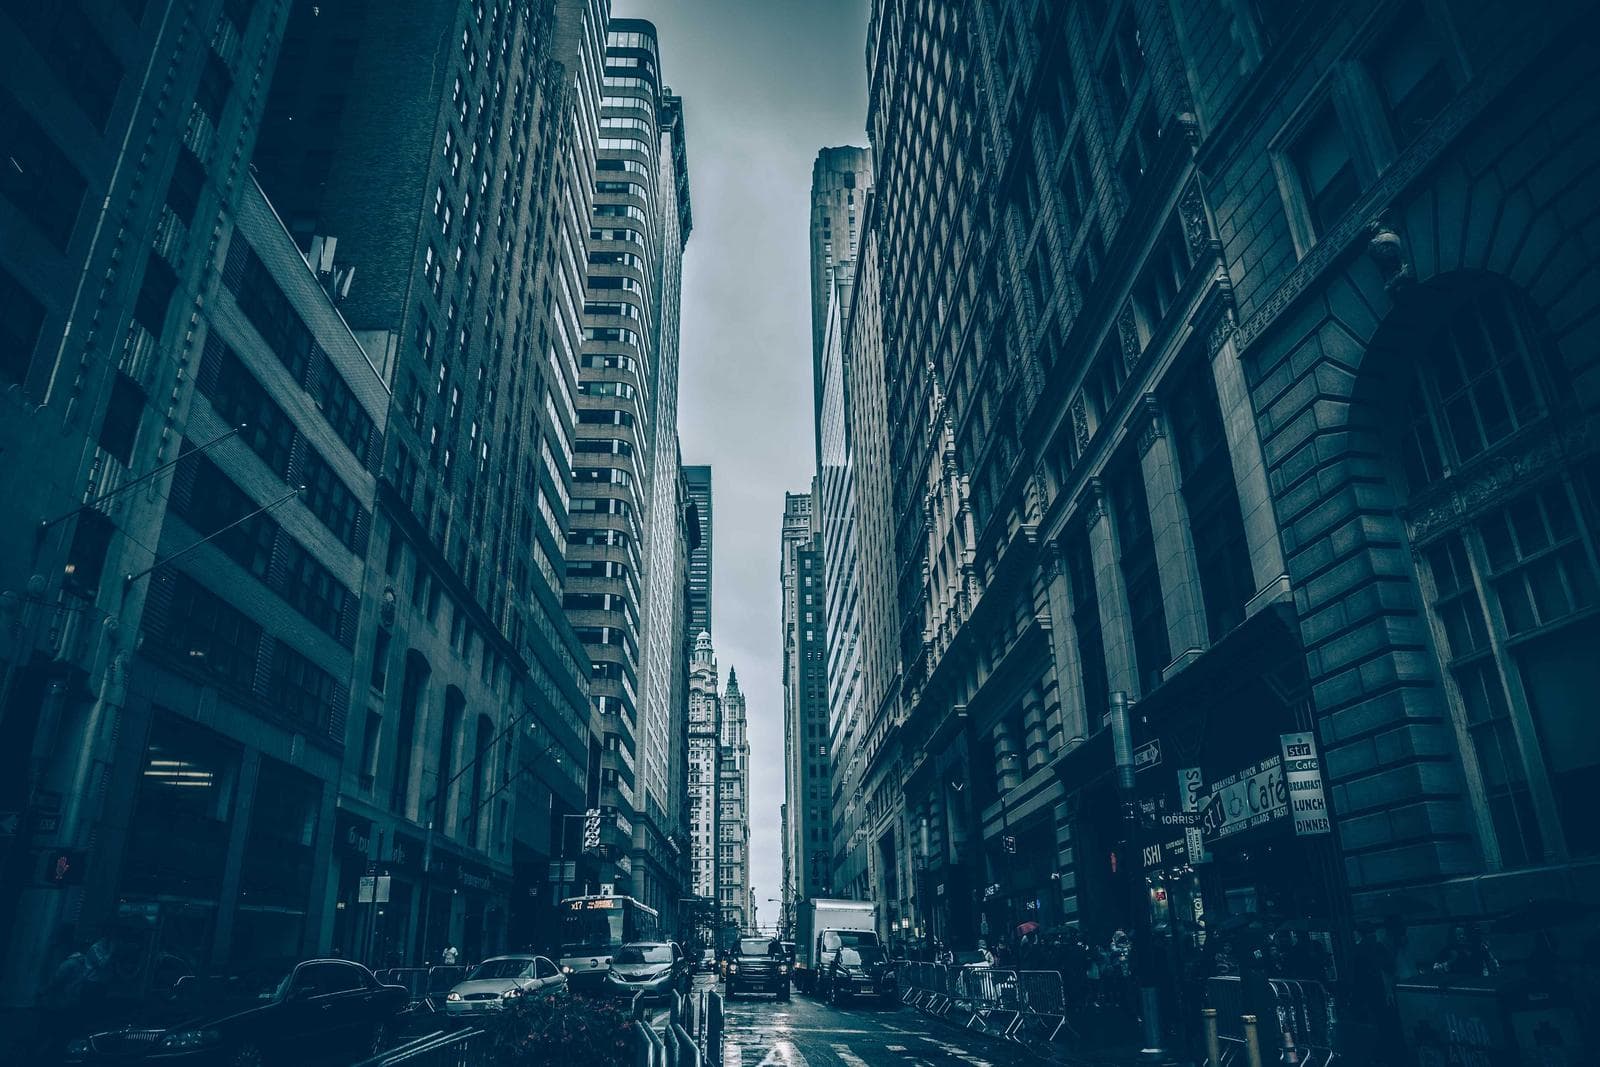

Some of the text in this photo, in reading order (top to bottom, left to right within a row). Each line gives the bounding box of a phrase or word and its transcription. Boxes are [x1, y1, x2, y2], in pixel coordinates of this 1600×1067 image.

[1288, 780, 1321, 791] BREAKFAST
[1248, 773, 1286, 813] Café
[1294, 799, 1324, 811] LUNCH
[1296, 819, 1329, 832] DINNER
